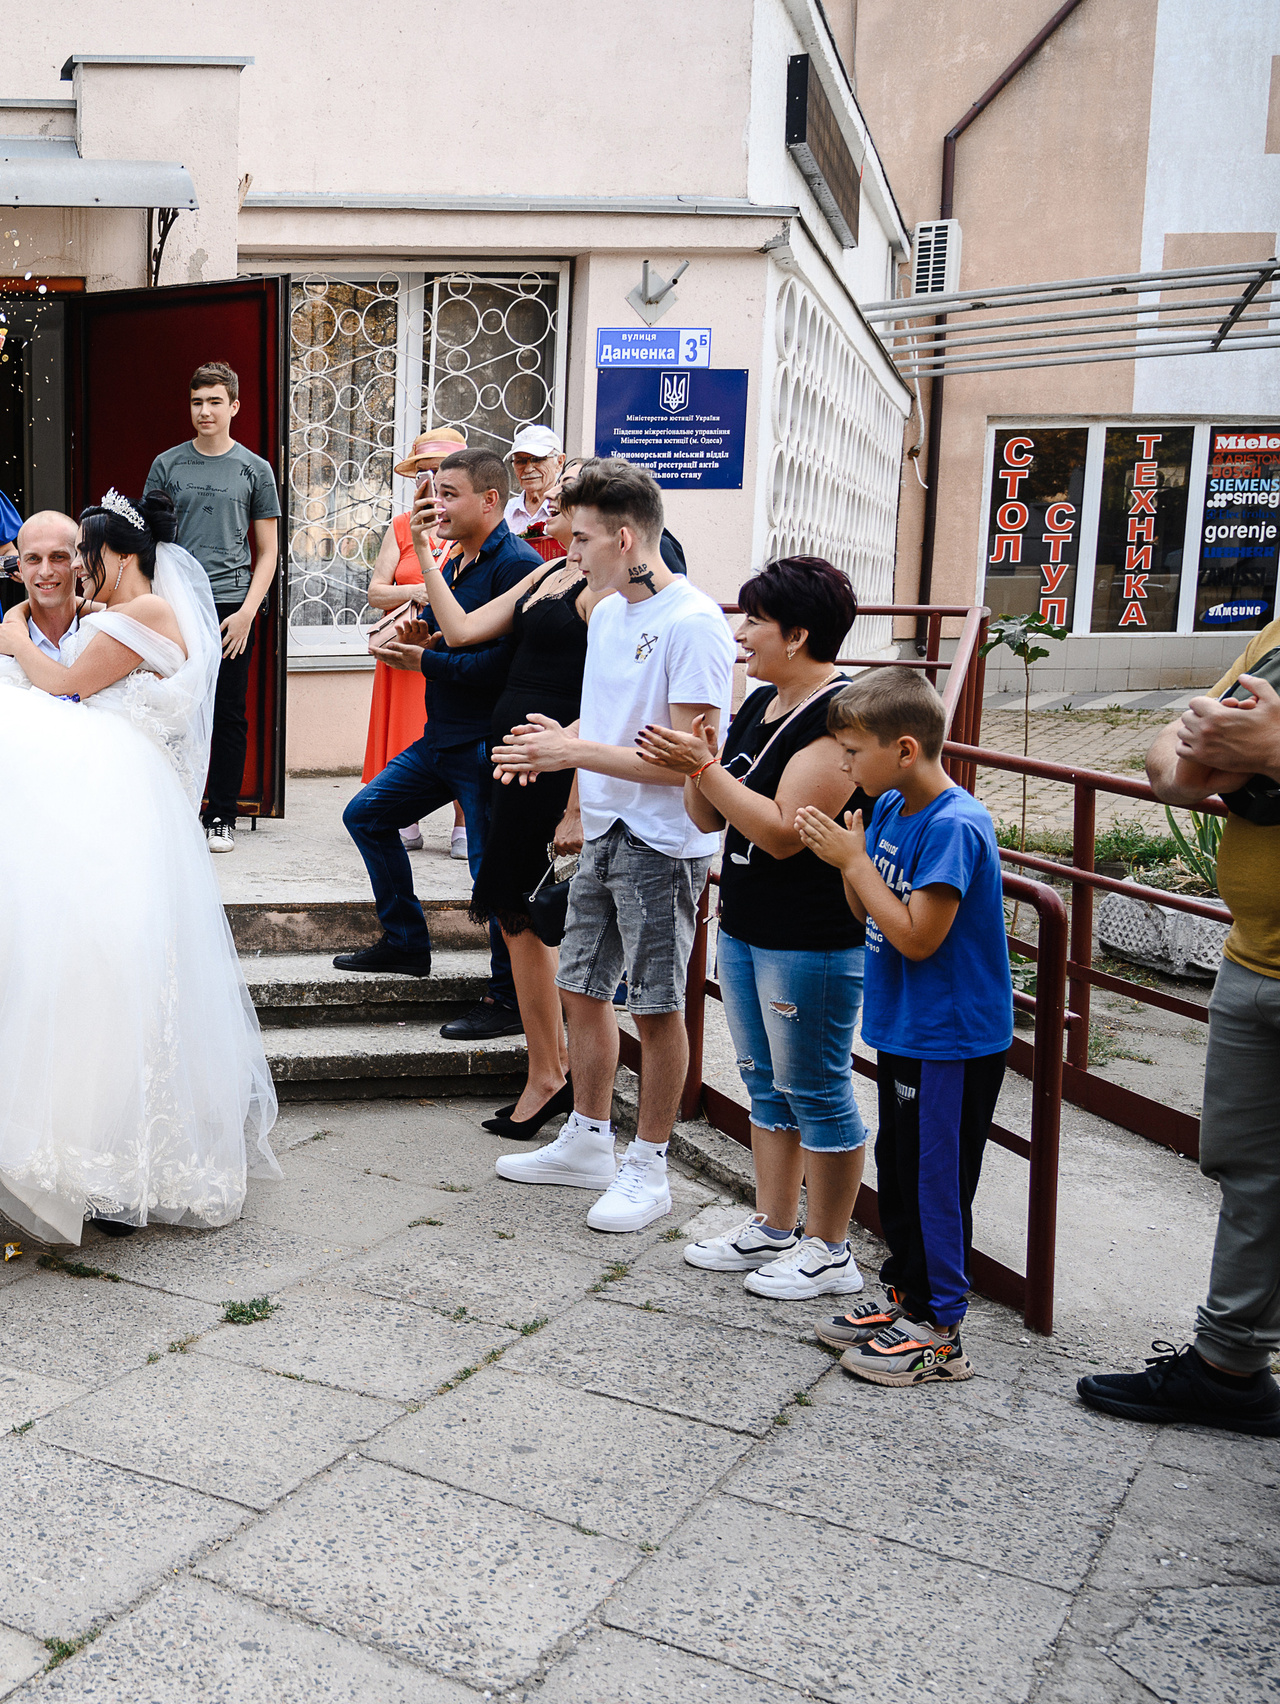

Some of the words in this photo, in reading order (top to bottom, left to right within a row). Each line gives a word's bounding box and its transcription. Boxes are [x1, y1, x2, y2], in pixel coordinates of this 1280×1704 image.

[621, 333, 657, 342] вулиця
[600, 344, 675, 362] Данченка
[613, 428, 643, 436] Південне
[644, 428, 694, 436] міжрегіональне
[694, 428, 731, 436] управління
[620, 437, 662, 445] Міністерства
[663, 437, 688, 445] юстиції
[1215, 435, 1280, 449] Miele
[673, 450, 705, 459] міський
[705, 450, 729, 459] відділ
[1225, 454, 1280, 466] ARISTON
[698, 461, 719, 469] актів
[646, 471, 679, 479] ільного
[680, 472, 702, 480] стану
[1212, 466, 1261, 478] BOSCH
[1209, 478, 1280, 492] SIEMENS
[989, 437, 1034, 563] СТОЛ
[1232, 492, 1280, 508] smeg
[1220, 508, 1277, 519] Electrolux
[1118, 433, 1162, 626] ТЕХНИКА
[1204, 521, 1277, 543] gorenje
[1203, 546, 1275, 558] LIEBHERR
[628, 563, 648, 576] ASAP
[1039, 502, 1076, 626] СТУЛ
[1208, 605, 1261, 616] SAMSUNG
